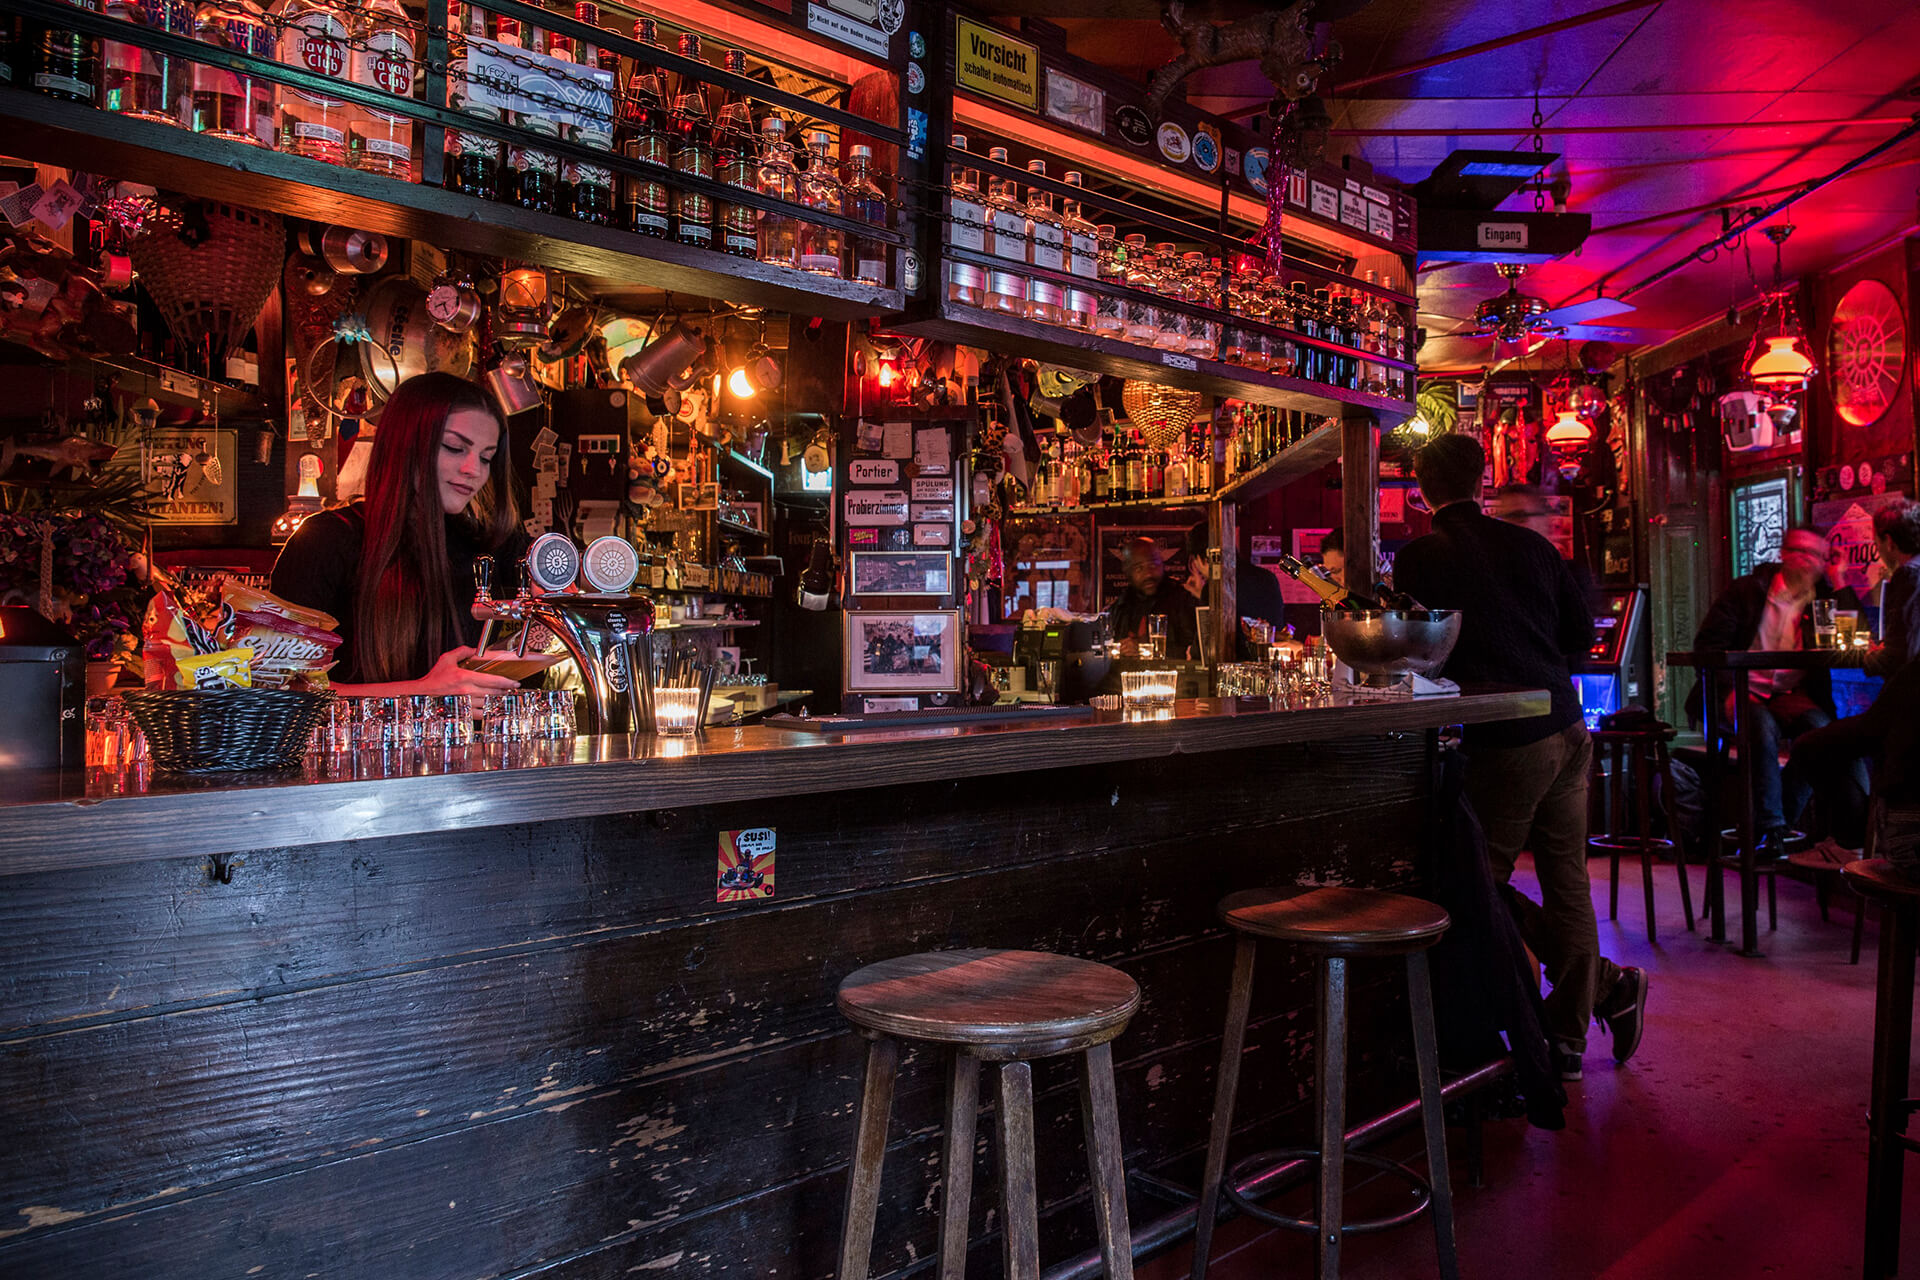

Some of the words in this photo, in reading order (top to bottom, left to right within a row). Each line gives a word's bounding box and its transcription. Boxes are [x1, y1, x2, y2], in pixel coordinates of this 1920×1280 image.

[816, 15, 829, 25] Nicht
[840, 24, 848, 33] den
[850, 28, 863, 39] Boden
[865, 33, 882, 46] spucken
[971, 32, 1027, 74] Vorsicht
[308, 54, 338, 72] Club
[379, 72, 406, 90] Club
[490, 67, 505, 79] FCZ
[963, 62, 991, 81] schaltet
[992, 72, 1033, 96] automatisch
[1485, 227, 1521, 243] Eingang
[856, 464, 893, 478] Portier
[848, 499, 904, 516] Probierzimmer
[1823, 533, 1880, 574] Snge
[743, 831, 771, 842] SUSI!
